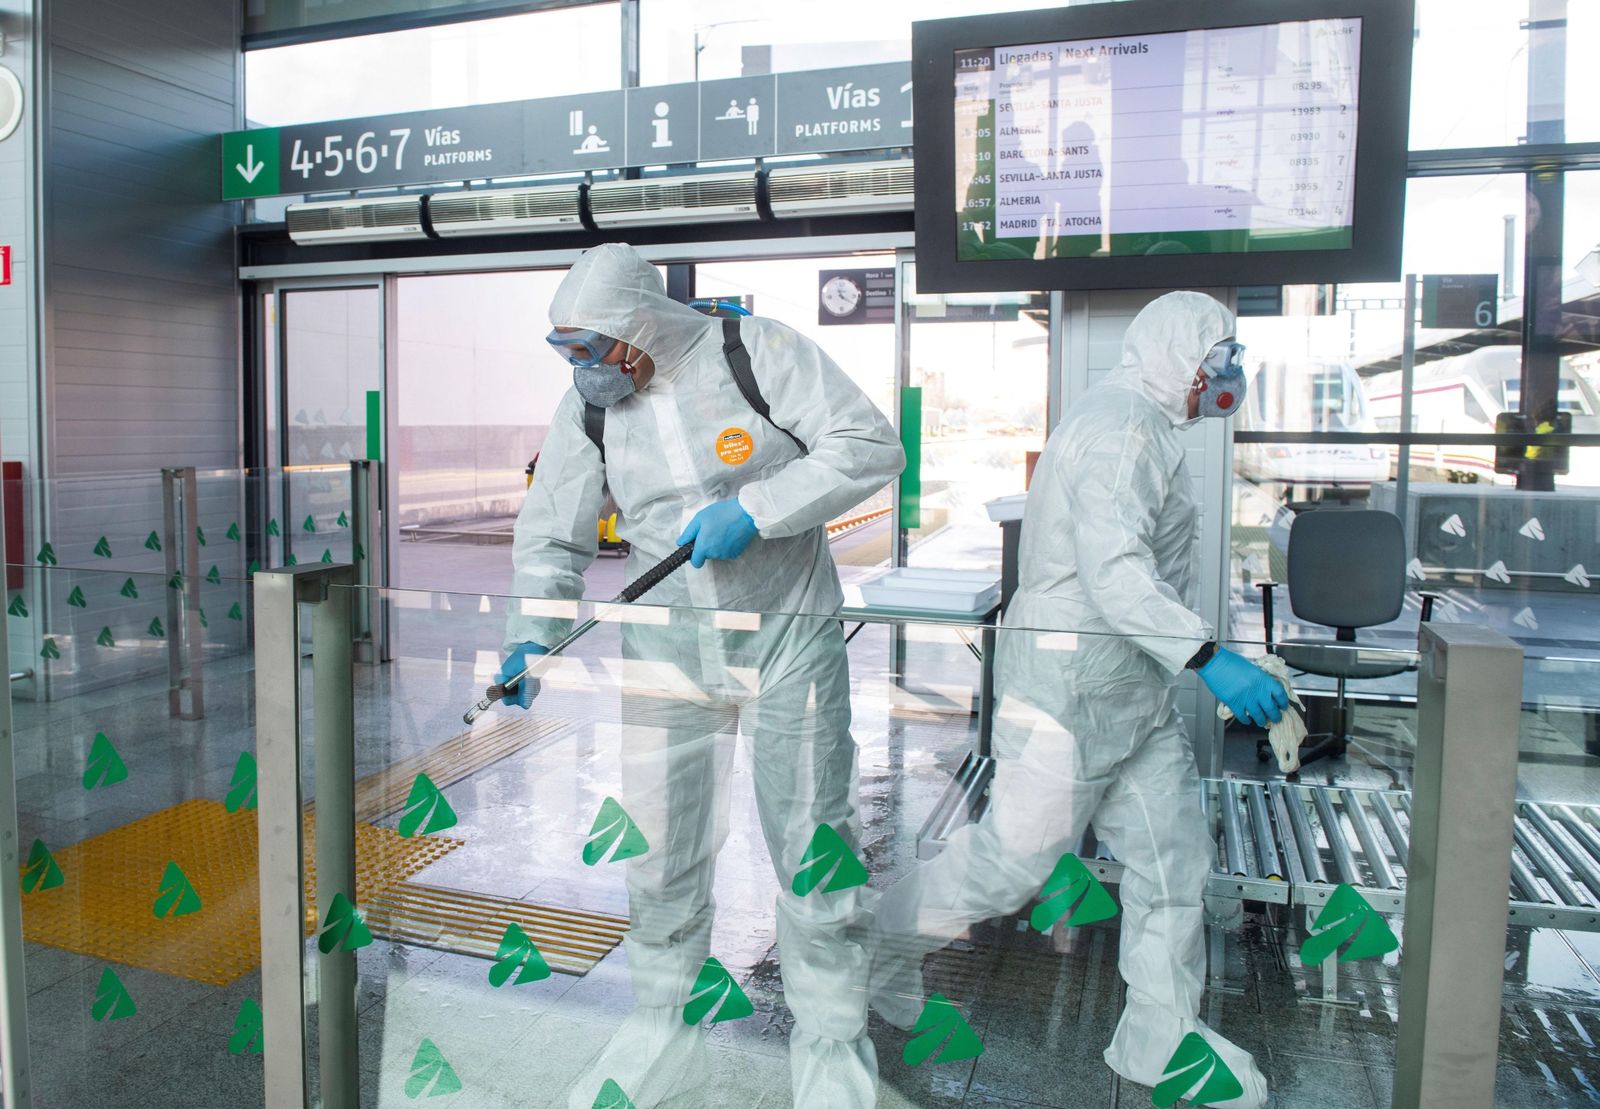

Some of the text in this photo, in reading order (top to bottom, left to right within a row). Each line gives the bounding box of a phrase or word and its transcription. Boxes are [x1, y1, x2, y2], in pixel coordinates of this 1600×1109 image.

[960, 57, 991, 69] 11:20
[1065, 46, 1095, 59] Next
[1100, 42, 1149, 57] Arrivals
[826, 83, 881, 110] Vías
[1340, 104, 1347, 114] 2
[424, 126, 461, 147] Vías
[795, 118, 881, 138] PLATFORMS
[1337, 130, 1346, 140] 4
[424, 148, 493, 167] PLATFORMS
[1074, 169, 1103, 179] JUSTA
[1337, 155, 1345, 166] 7
[999, 196, 1041, 206] ALMERIA
[1336, 181, 1344, 191] 2
[1000, 219, 1038, 229] MADRID
[1065, 216, 1102, 227] ATOCHA
[1475, 300, 1493, 327] 6
